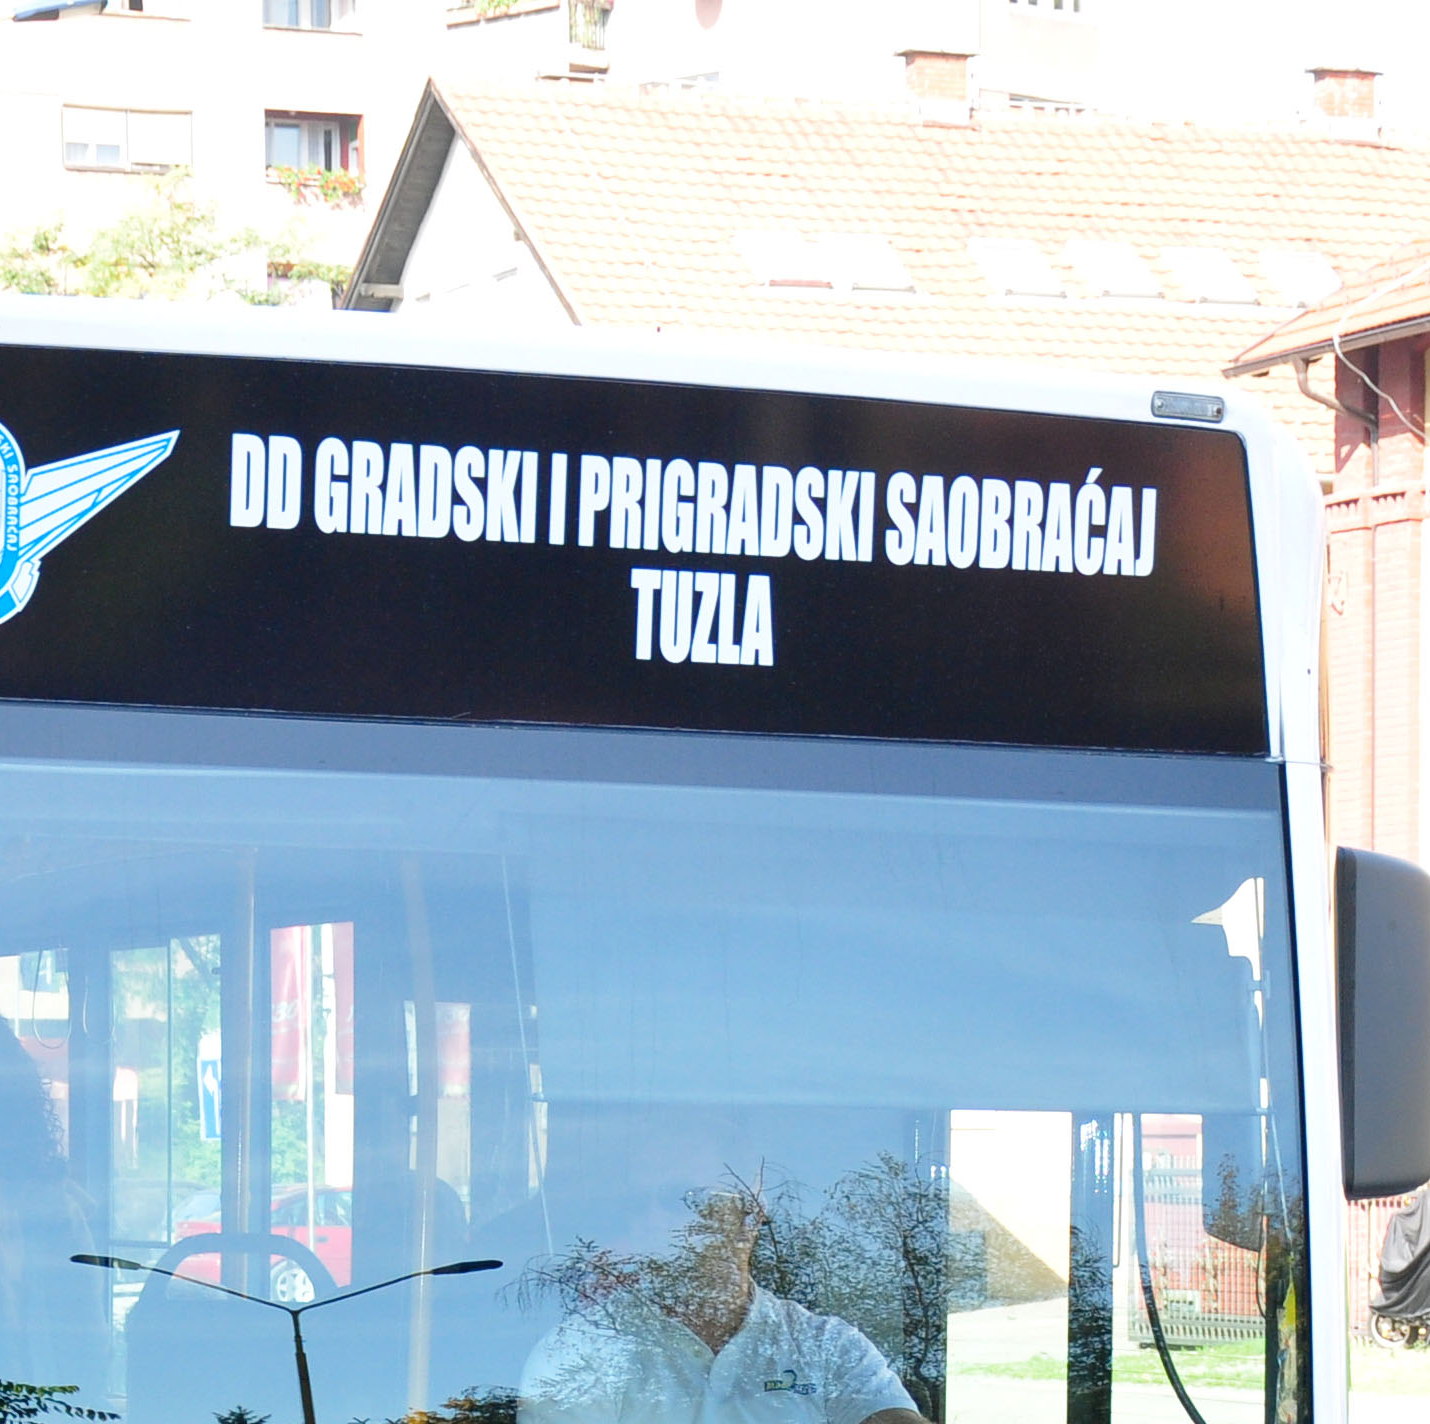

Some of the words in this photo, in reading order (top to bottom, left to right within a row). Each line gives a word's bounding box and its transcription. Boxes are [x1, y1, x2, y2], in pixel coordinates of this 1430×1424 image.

[230, 433, 303, 530] DD
[315, 437, 539, 543] GRADSKI
[548, 453, 568, 545] I
[578, 455, 876, 562] PRIGRADSKI
[885, 465, 1157, 577] SAOBRAĆAJ
[631, 568, 775, 667] TUZLA
